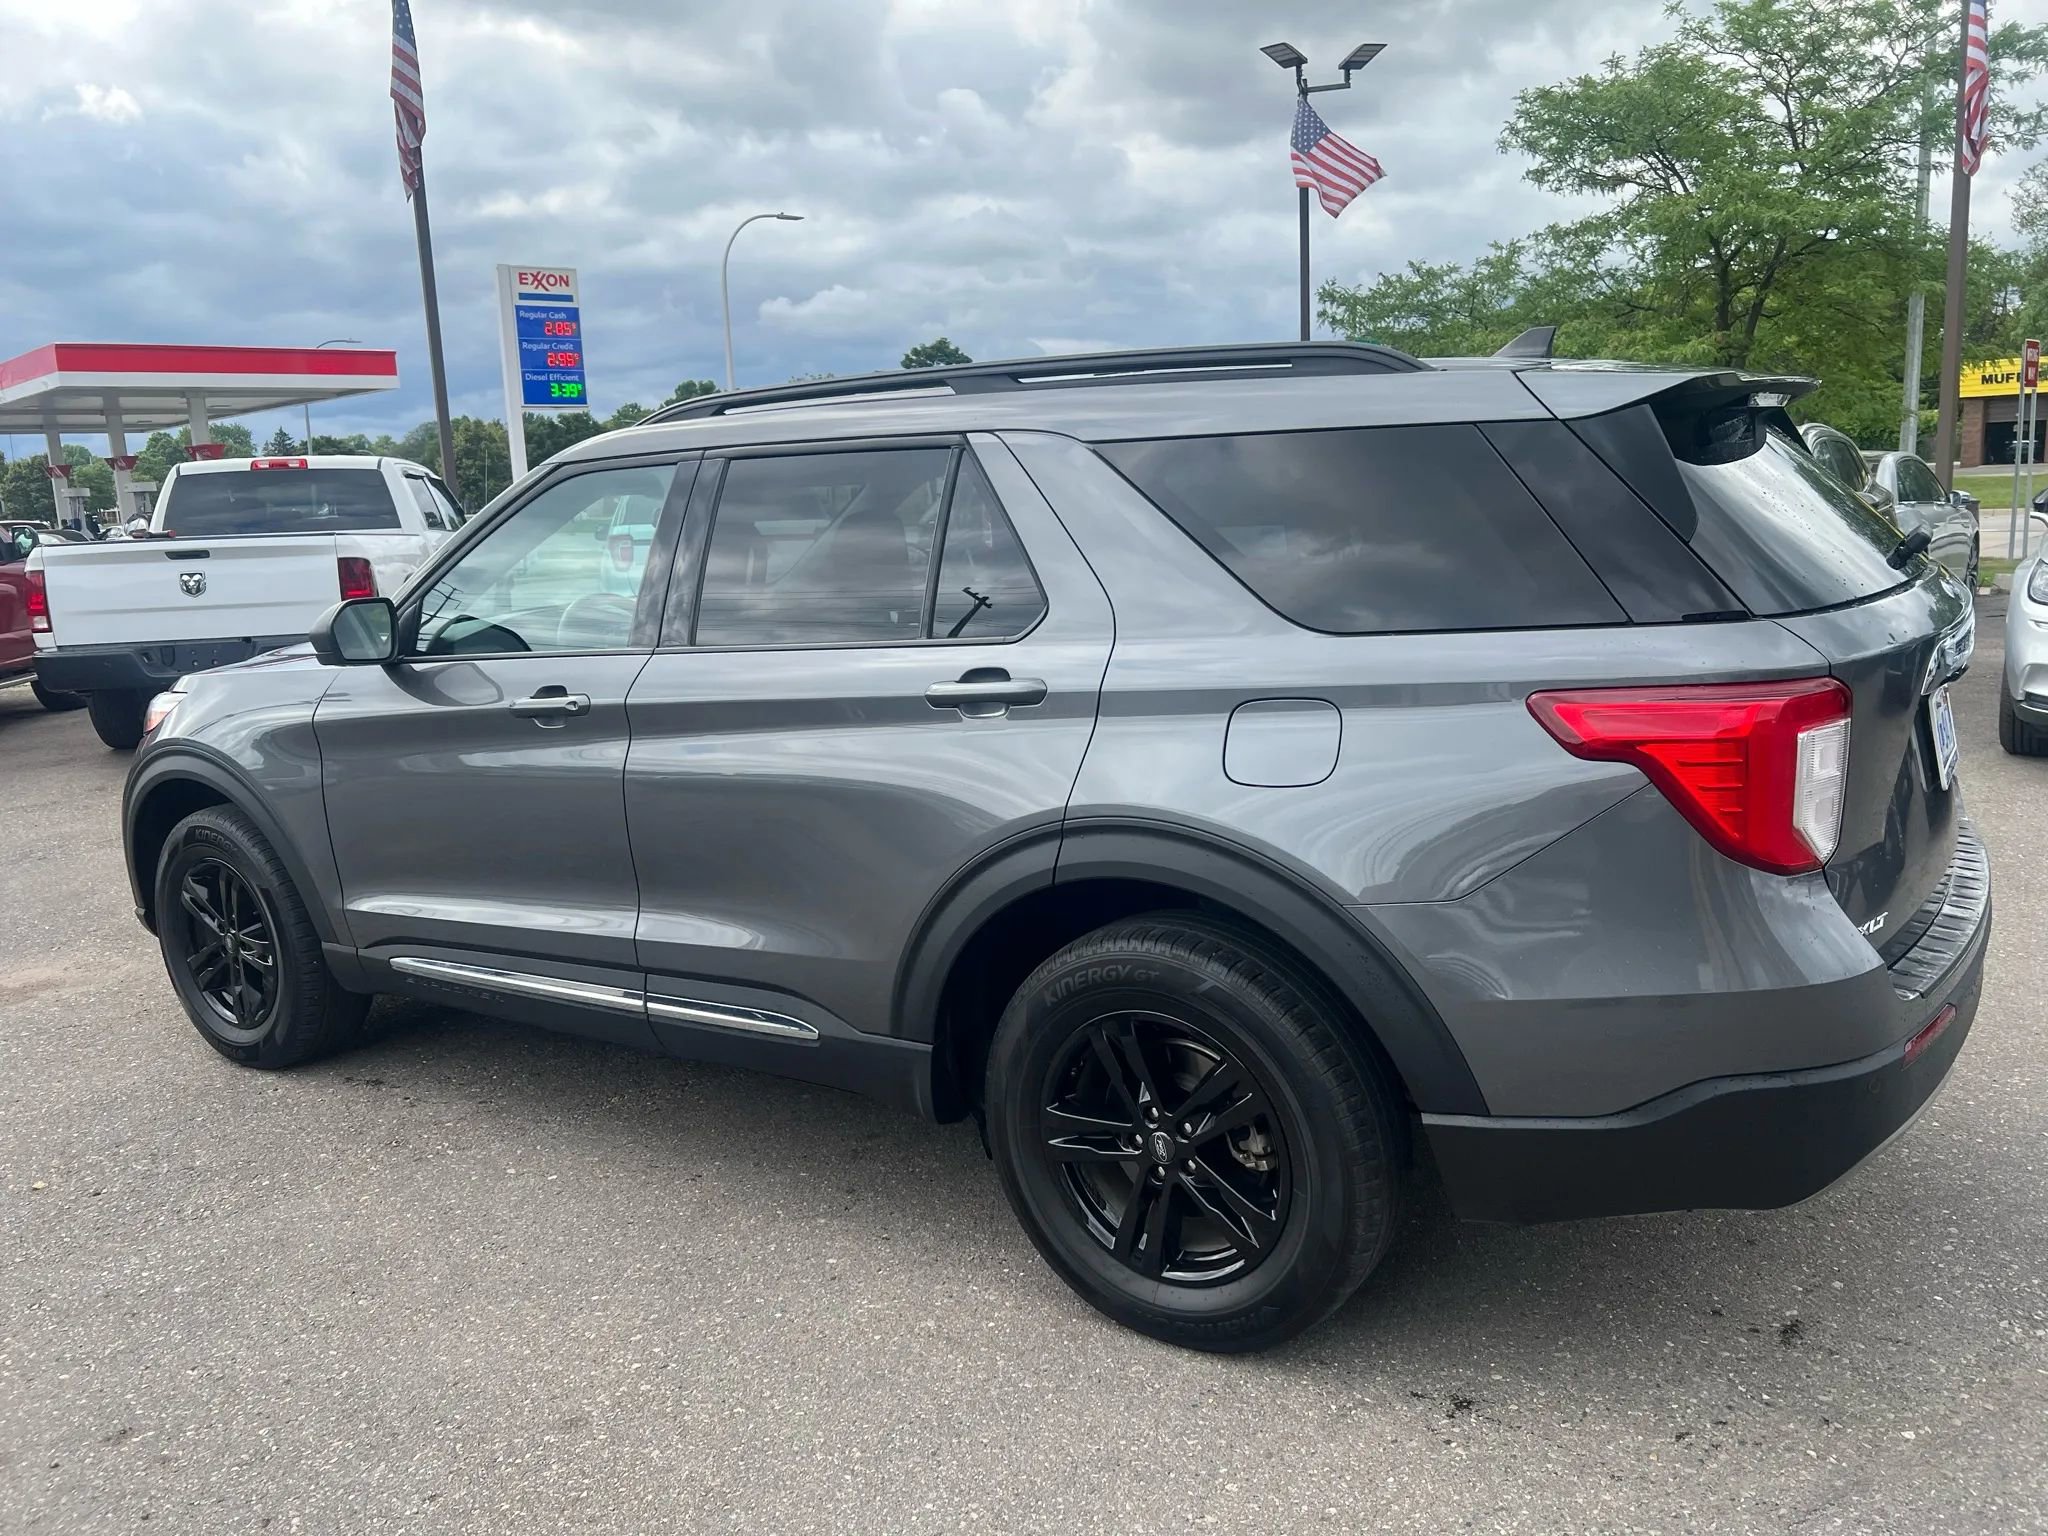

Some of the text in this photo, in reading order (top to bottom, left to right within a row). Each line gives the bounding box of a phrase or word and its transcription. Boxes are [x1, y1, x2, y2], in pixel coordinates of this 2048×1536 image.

[518, 271, 570, 291] EXXON
[519, 310, 567, 320] Regular Cash
[522, 341, 574, 352] Regular Credit
[525, 373, 580, 382] Diesel Efficient
[1857, 911, 1889, 936] XLT
[1044, 964, 1160, 1007] KINERGY GT
